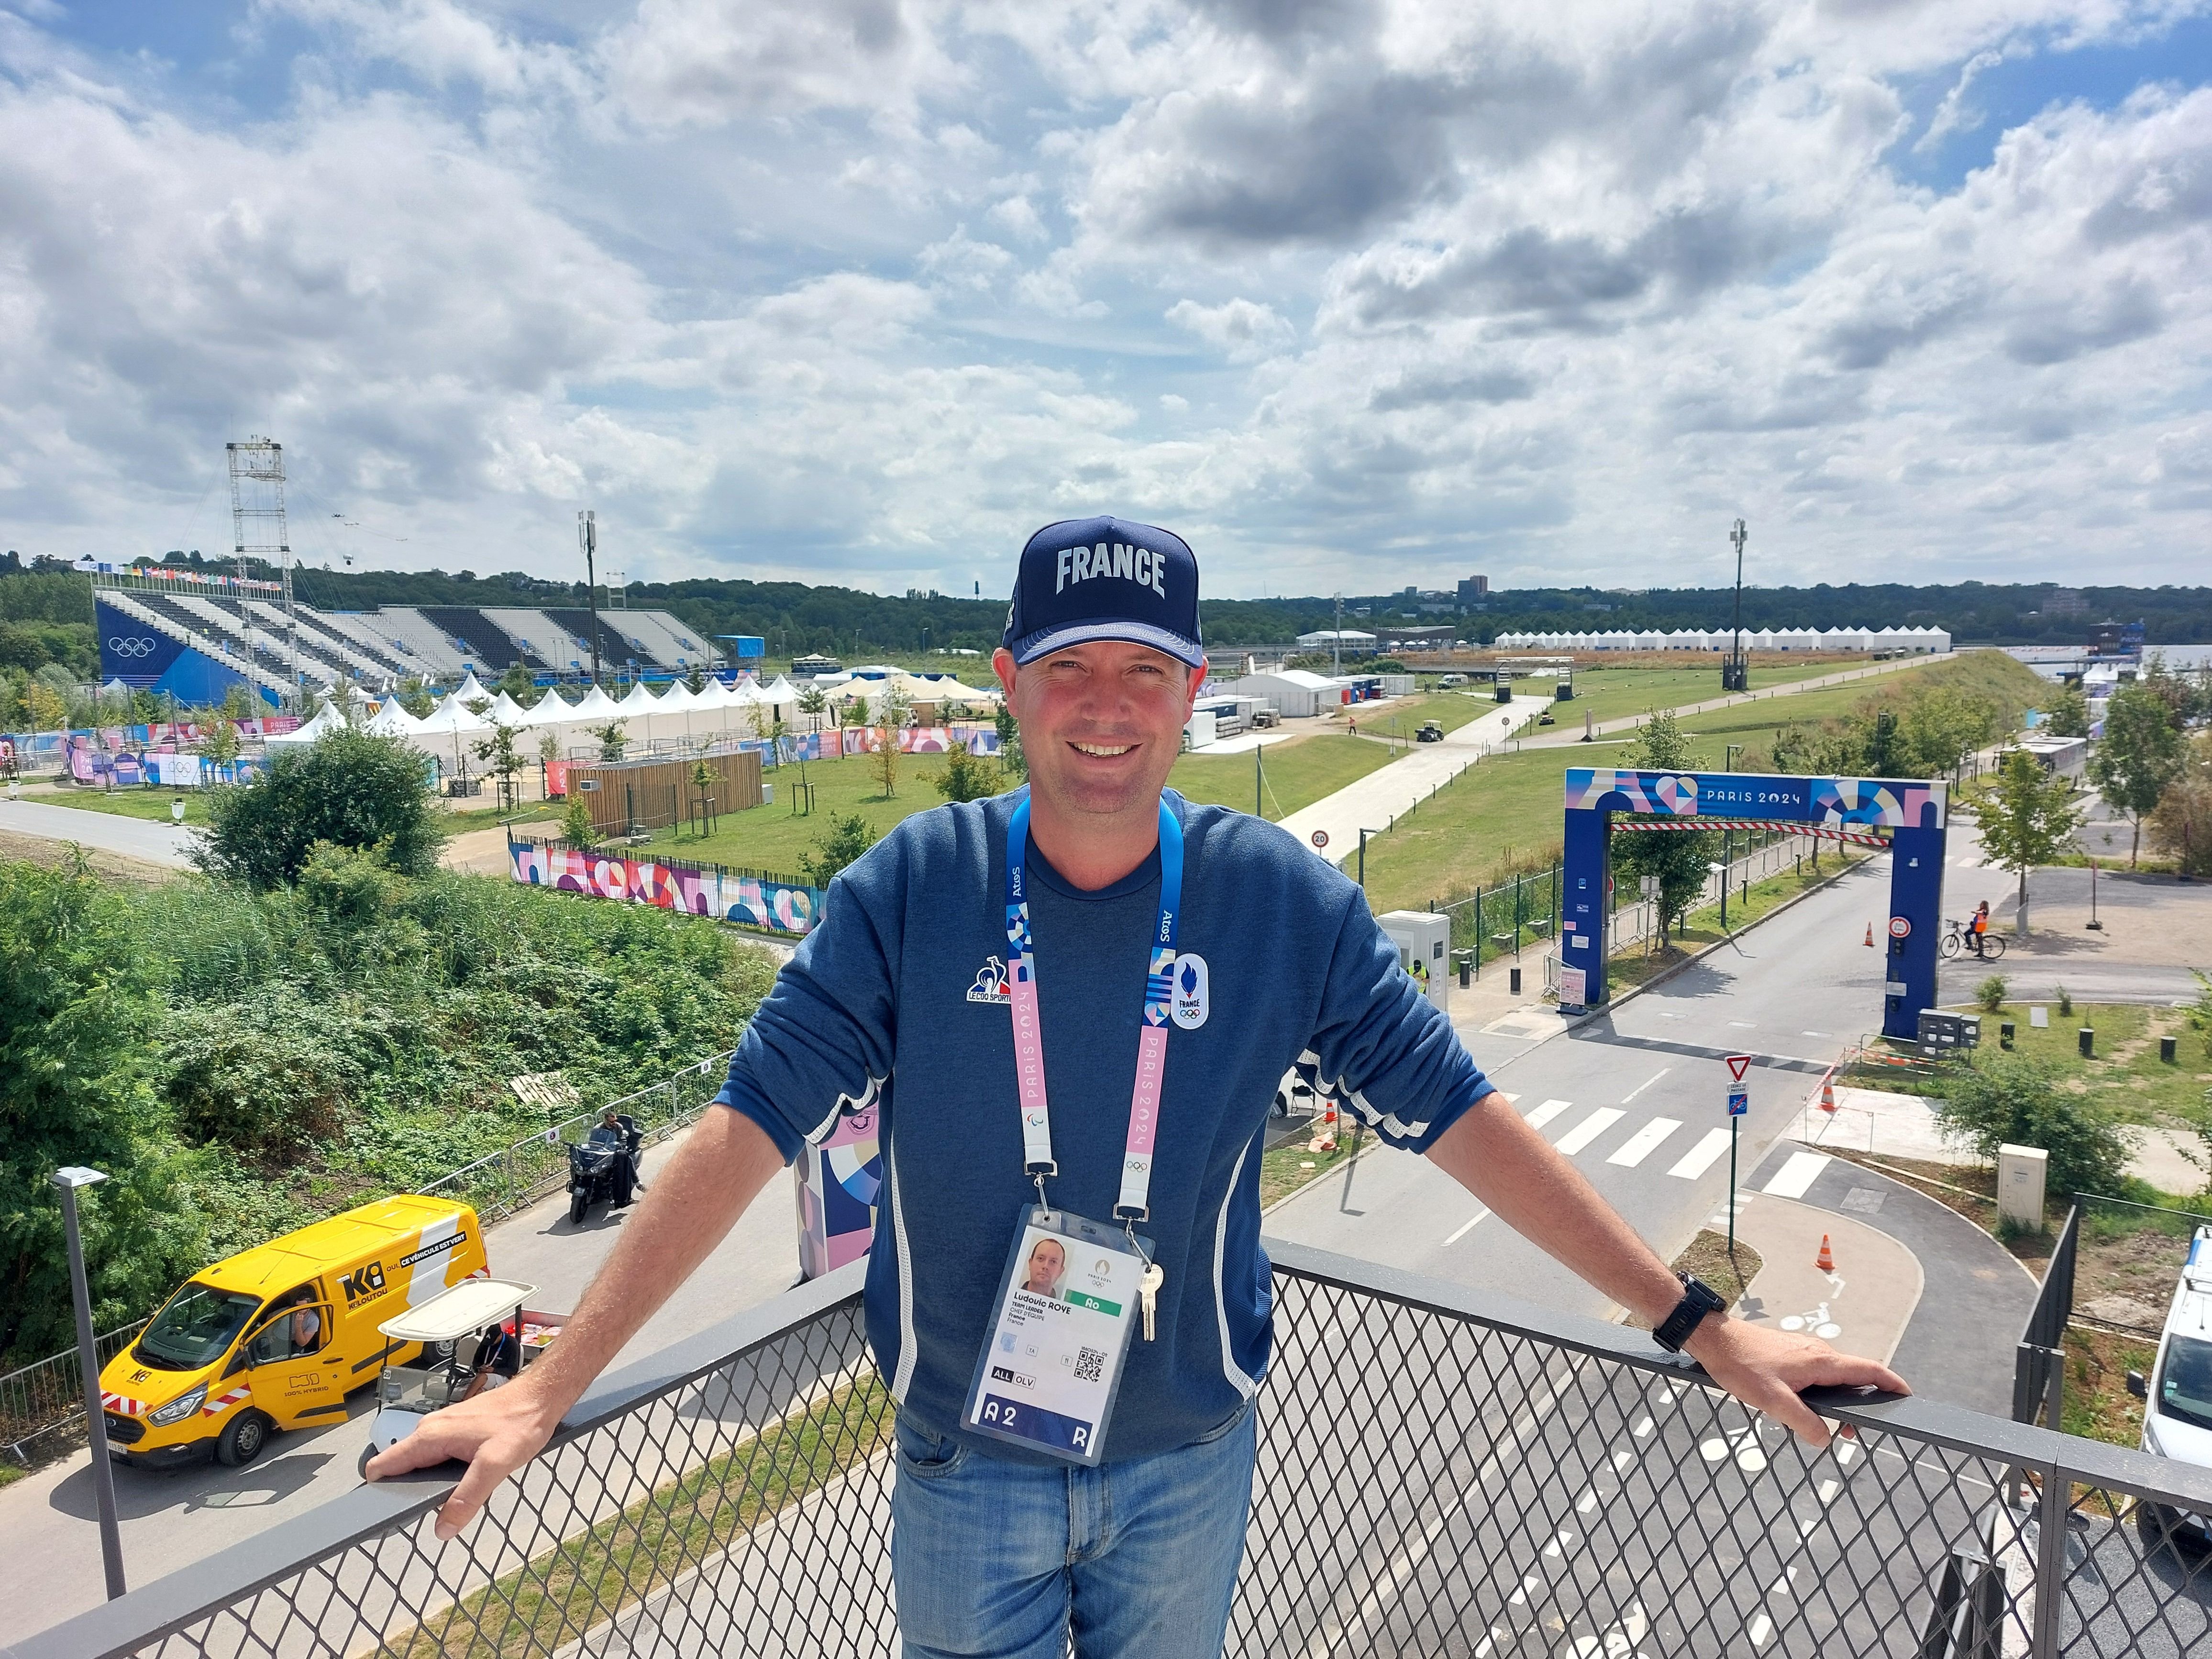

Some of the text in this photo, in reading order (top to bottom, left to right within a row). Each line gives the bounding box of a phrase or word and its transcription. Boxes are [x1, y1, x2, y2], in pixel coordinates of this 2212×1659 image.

[1056, 543, 1165, 599] FRANCE
[1759, 792, 1800, 804] 2024
[1012, 866, 1021, 897] Atos
[1160, 909, 1172, 942] Atos
[990, 994, 1011, 1002] SPORTI
[1179, 998, 1200, 1008] FRANCE
[1018, 992, 1033, 1039] 2024
[1134, 1096, 1151, 1144] 2024
[387, 1263, 400, 1272] OUI,
[409, 1245, 439, 1264] VÉHICULE
[439, 1241, 450, 1250] EST
[449, 1234, 465, 1245] VERT
[1014, 1292, 1047, 1307] Ludovic
[1009, 1313, 1025, 1321] France
[1026, 1305, 1043, 1314] LEADER
[1007, 1317, 1024, 1326] France
[994, 1369, 1010, 1381] ALL
[1016, 1376, 1034, 1386] OLV
[984, 1402, 1017, 1426] A 2
[1072, 1427, 1087, 1447] R
